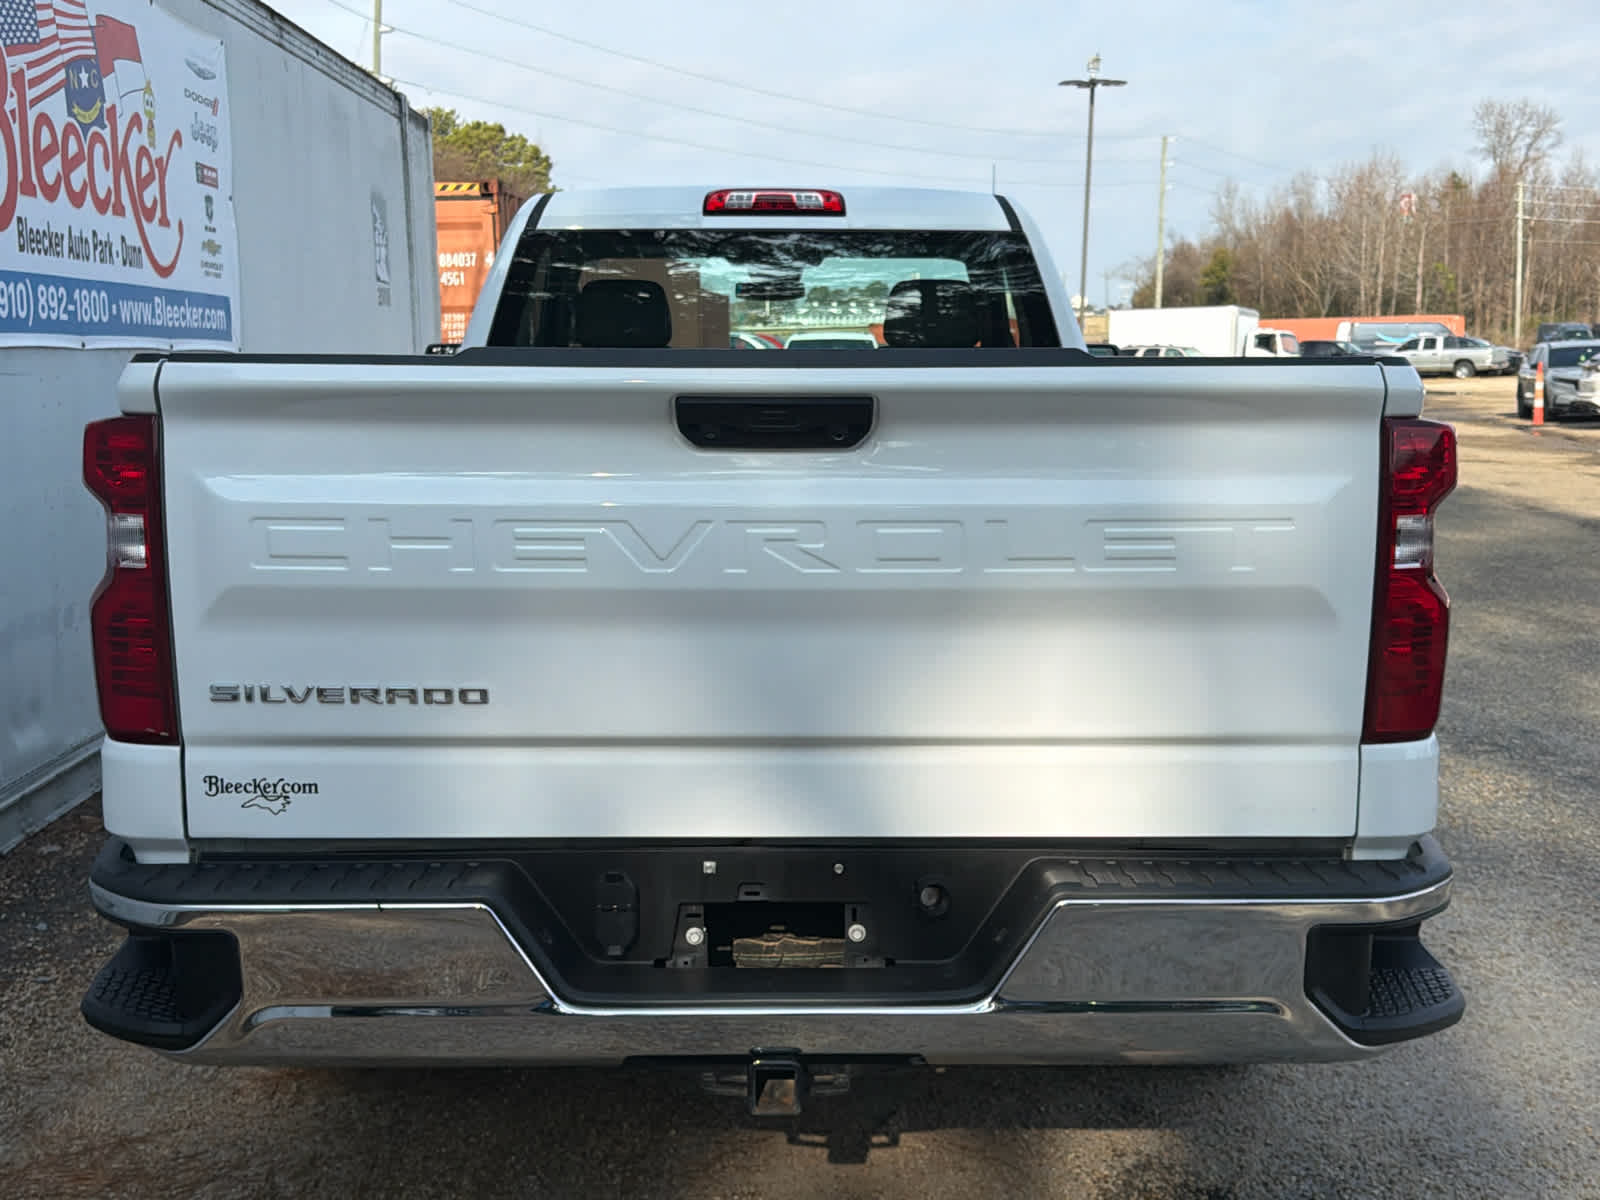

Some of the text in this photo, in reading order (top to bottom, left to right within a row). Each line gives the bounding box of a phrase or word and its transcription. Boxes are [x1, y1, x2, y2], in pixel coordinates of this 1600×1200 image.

[69, 67, 99, 89] N C
[17, 216, 144, 269] Bleecker Auto Park Dunn
[37, 284, 109, 324] 892-1800
[119, 295, 227, 331] www.Bleecker.com
[250, 517, 1296, 573] CHEVROLET
[209, 684, 490, 705] SILVERADO
